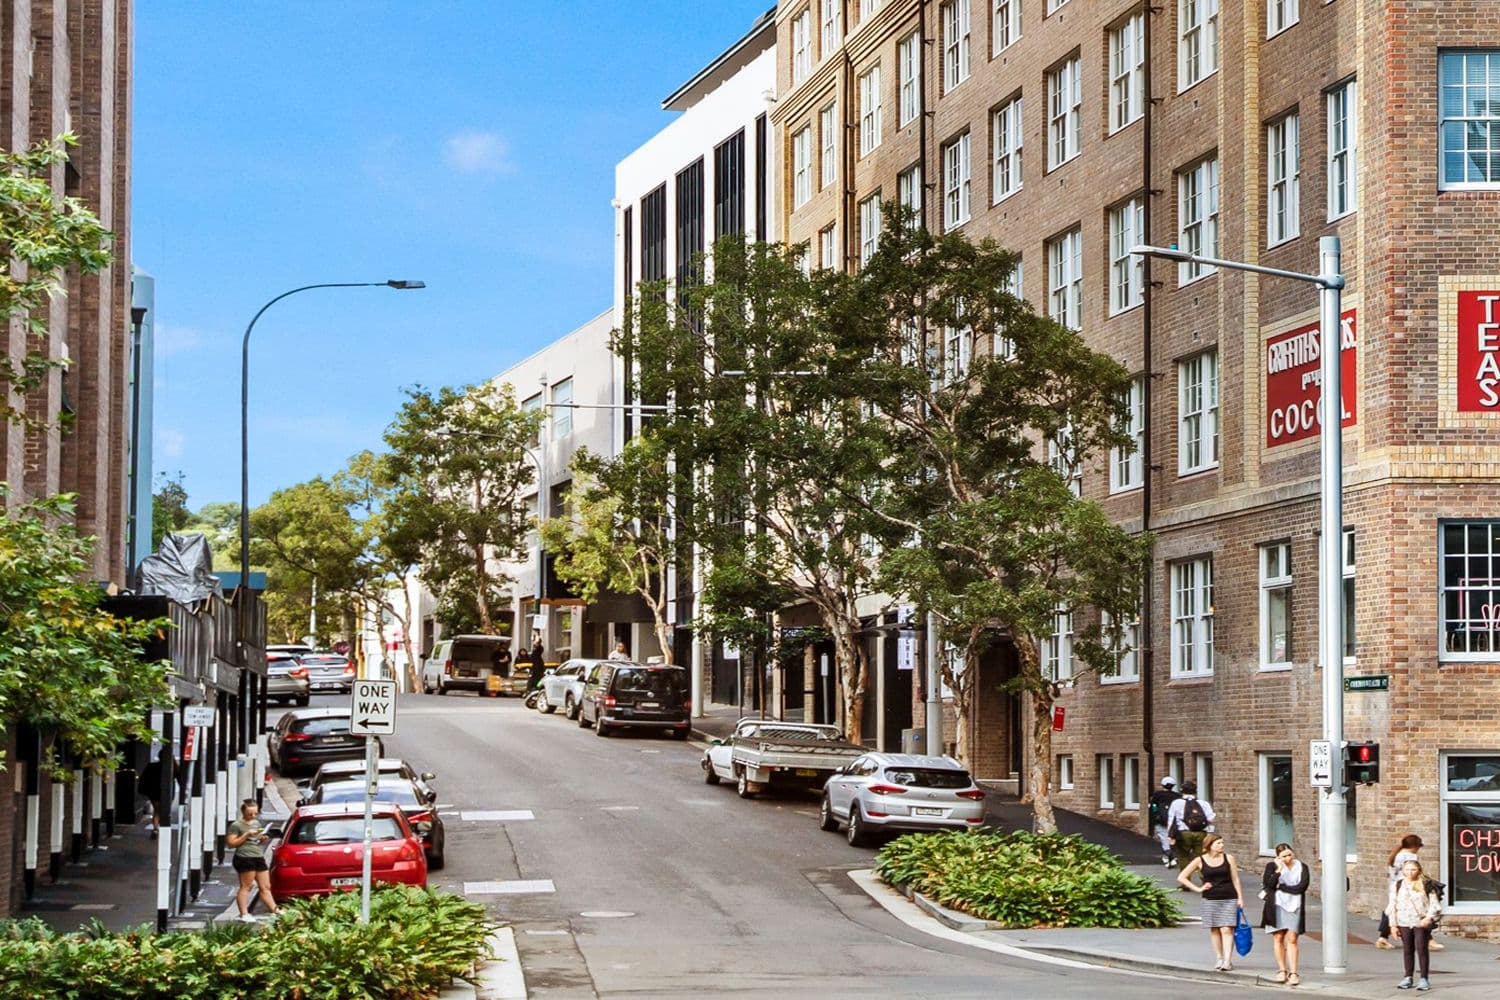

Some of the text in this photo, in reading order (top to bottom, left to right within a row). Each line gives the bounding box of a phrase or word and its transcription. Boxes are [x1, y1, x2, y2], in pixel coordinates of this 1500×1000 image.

[1268, 329, 1320, 374] GRIFFITHS
[360, 685, 389, 698] ONE
[359, 702, 389, 714] WAY
[1313, 745, 1328, 756] ONE
[1313, 759, 1328, 769] WAY
